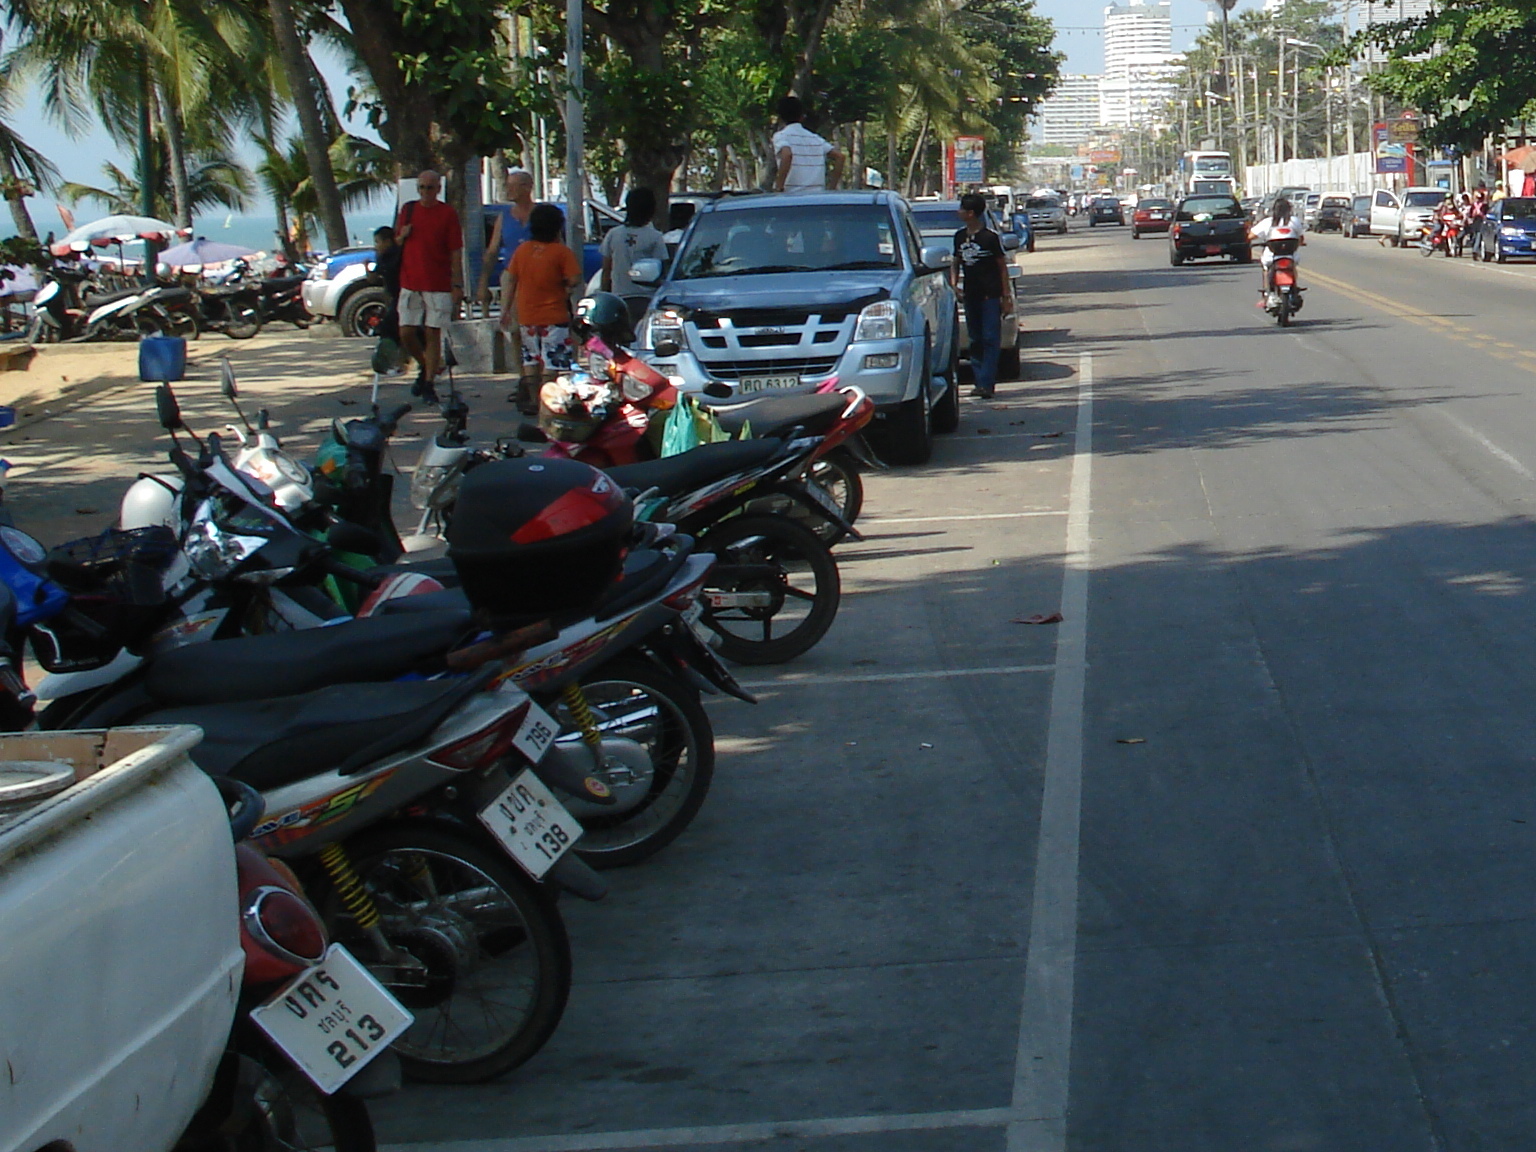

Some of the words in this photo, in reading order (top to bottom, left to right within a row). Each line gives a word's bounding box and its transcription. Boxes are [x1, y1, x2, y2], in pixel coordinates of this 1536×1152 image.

[525, 721, 552, 751] 796
[535, 823, 569, 860] 138
[317, 999, 353, 1034] ชลบุรี
[327, 1014, 386, 1069] 213
